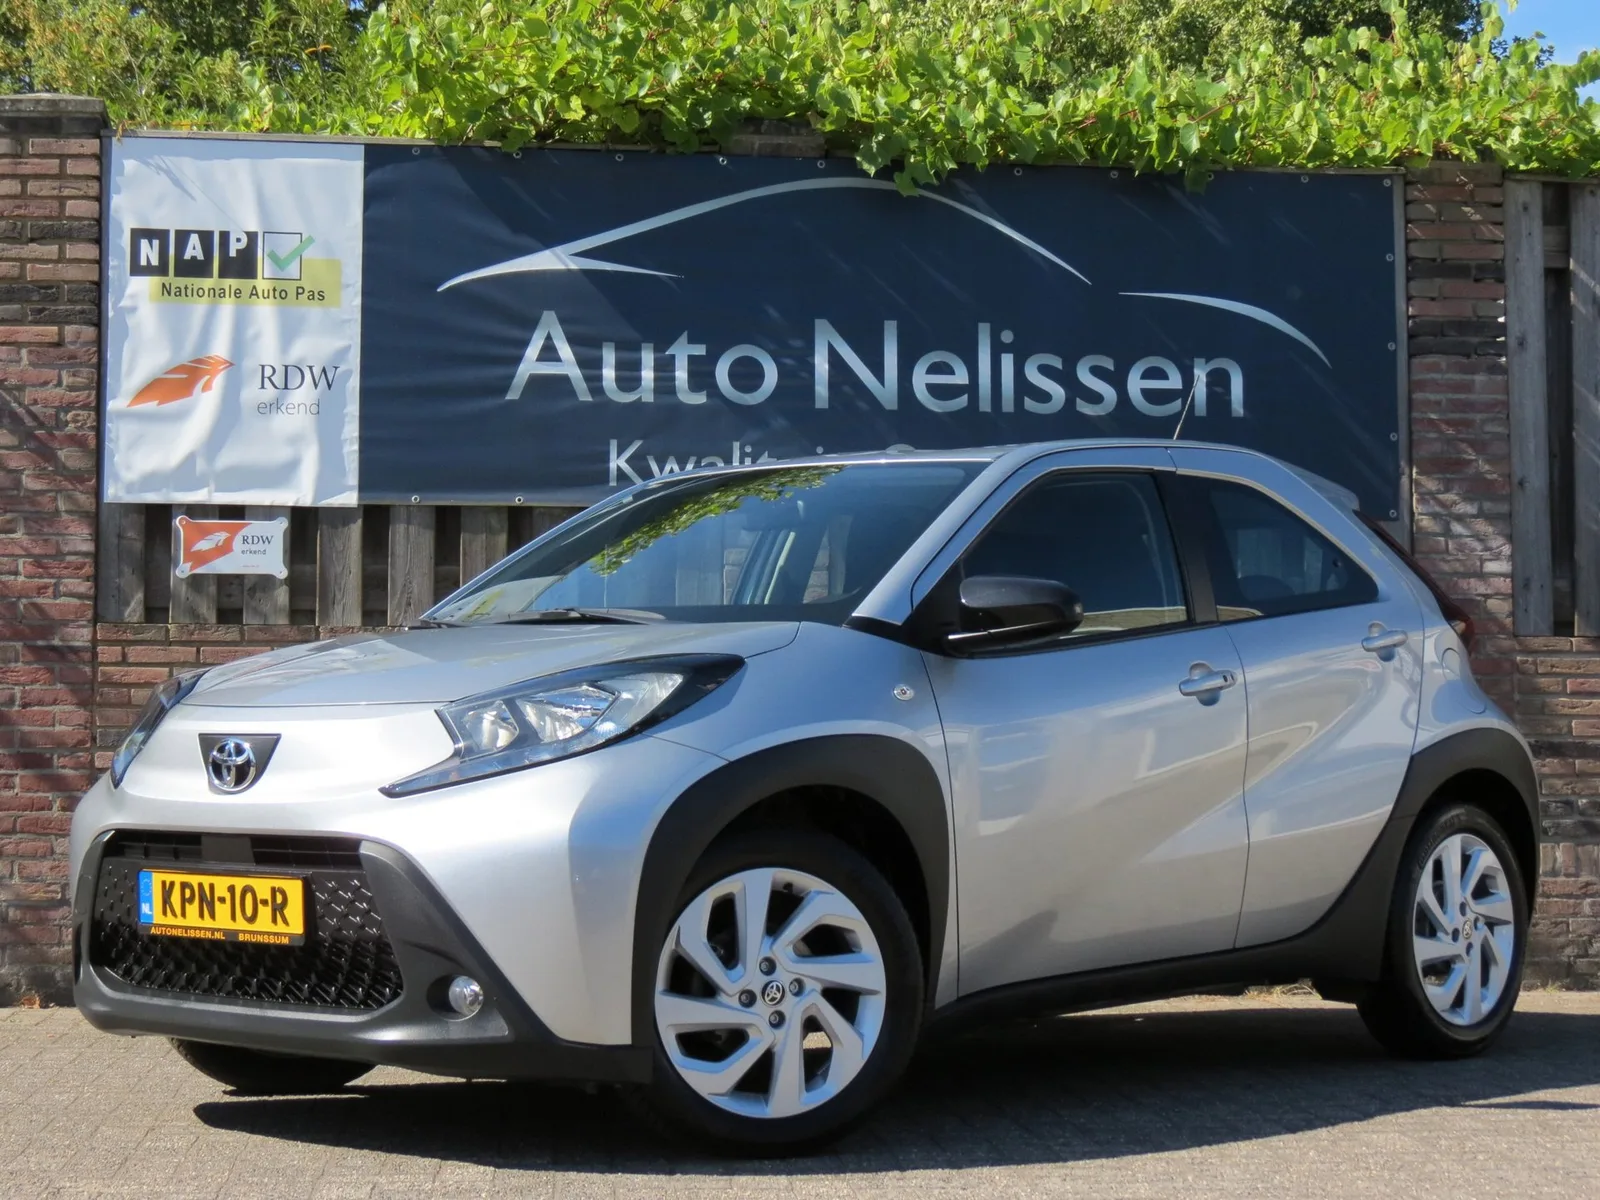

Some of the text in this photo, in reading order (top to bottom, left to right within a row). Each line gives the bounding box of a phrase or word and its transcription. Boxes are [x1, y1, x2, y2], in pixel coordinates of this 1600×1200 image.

[139, 233, 248, 266] NAP
[161, 282, 325, 301] Nationale Auto Pas
[505, 310, 1245, 418] Auto Nelissen
[258, 364, 340, 391] RDW
[257, 398, 320, 415] erkend
[241, 535, 274, 545] RDW
[142, 902, 152, 914] NL
[161, 880, 290, 926] KPN-10-R
[151, 927, 290, 944] AUTONELISSEN.NL BRUNSSUM
